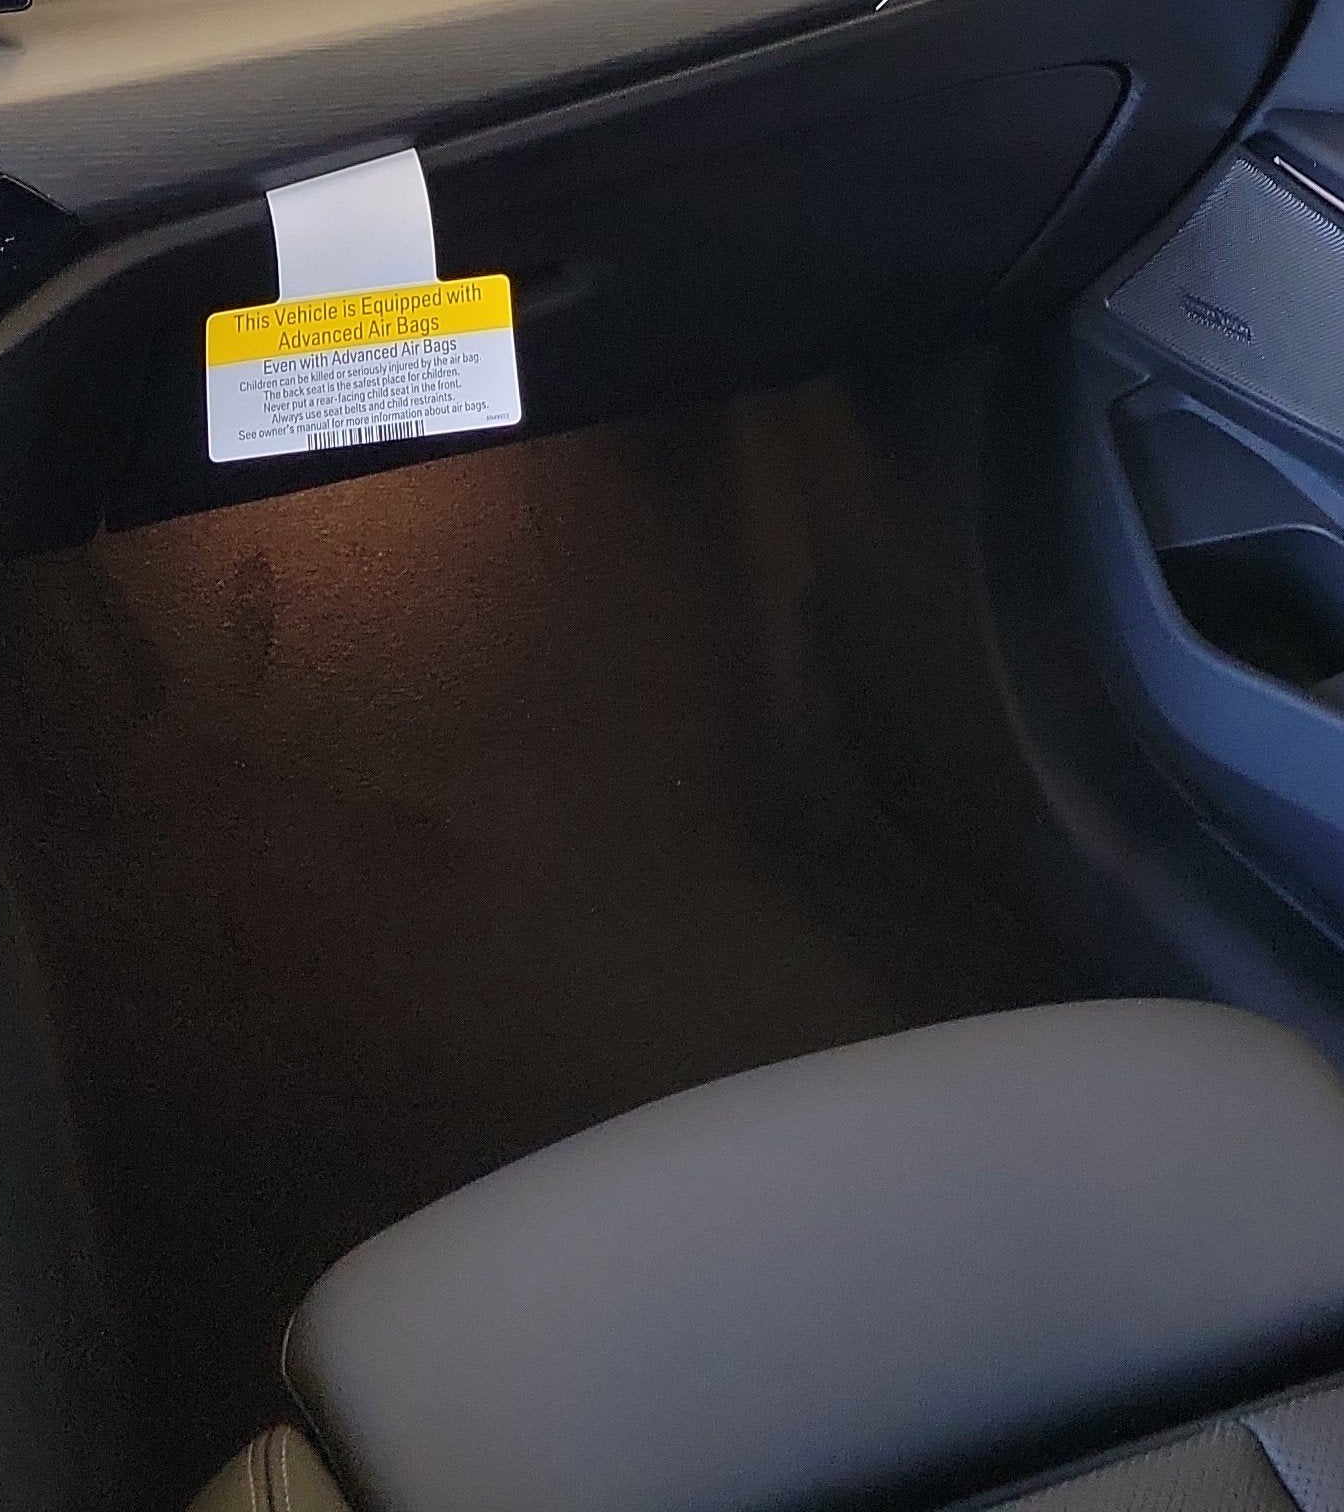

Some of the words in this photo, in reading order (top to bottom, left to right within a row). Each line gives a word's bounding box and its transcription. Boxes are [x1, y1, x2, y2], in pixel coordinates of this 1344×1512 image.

[233, 311, 270, 333] This
[274, 301, 338, 327] Vehicle
[343, 299, 356, 318] is
[361, 286, 443, 318] Equipped
[446, 283, 482, 305] with
[278, 321, 363, 351] Advanced
[368, 319, 392, 339] Air
[397, 315, 440, 336] Bags
[239, 378, 278, 392] Children
[279, 377, 296, 387] can
[297, 374, 310, 385] be
[310, 370, 335, 382] killed
[336, 369, 346, 379] or
[347, 363, 388, 378] seriously
[388, 360, 419, 375] injured
[421, 358, 432, 369] by
[433, 356, 448, 367] the
[449, 354, 460, 364] air
[463, 353, 482, 364] bag.
[263, 359, 297, 375] Even
[299, 352, 329, 370] with
[332, 343, 398, 366] Advanced
[401, 341, 420, 357] Air
[423, 338, 457, 355] Bags
[263, 390, 282, 401] The
[283, 388, 305, 399] back
[306, 384, 326, 396] seat
[327, 382, 335, 392] is
[336, 381, 352, 391] the
[353, 376, 380, 389] safest
[382, 374, 406, 387] place
[407, 371, 420, 382] for
[421, 368, 460, 381] children.
[263, 402, 290, 414] Never
[292, 399, 307, 411] put
[308, 397, 315, 407] a
[316, 391, 366, 407] rear-facing
[367, 388, 389, 400] child
[390, 385, 410, 396] seat
[411, 384, 420, 394] in
[421, 381, 436, 392] the
[437, 378, 462, 390] front.
[238, 430, 257, 441] See
[258, 424, 295, 439] owner's
[296, 419, 330, 434] manual
[331, 417, 345, 429] for
[346, 415, 370, 426] more
[371, 408, 423, 424] information
[424, 404, 450, 418] about
[451, 402, 463, 414] air
[464, 400, 490, 413] bags.
[271, 413, 304, 425] Always
[305, 410, 322, 420] use
[323, 406, 344, 418] seat
[345, 403, 367, 415] belts
[368, 401, 386, 412] and
[387, 397, 409, 409] child
[410, 392, 456, 406] restraints.
